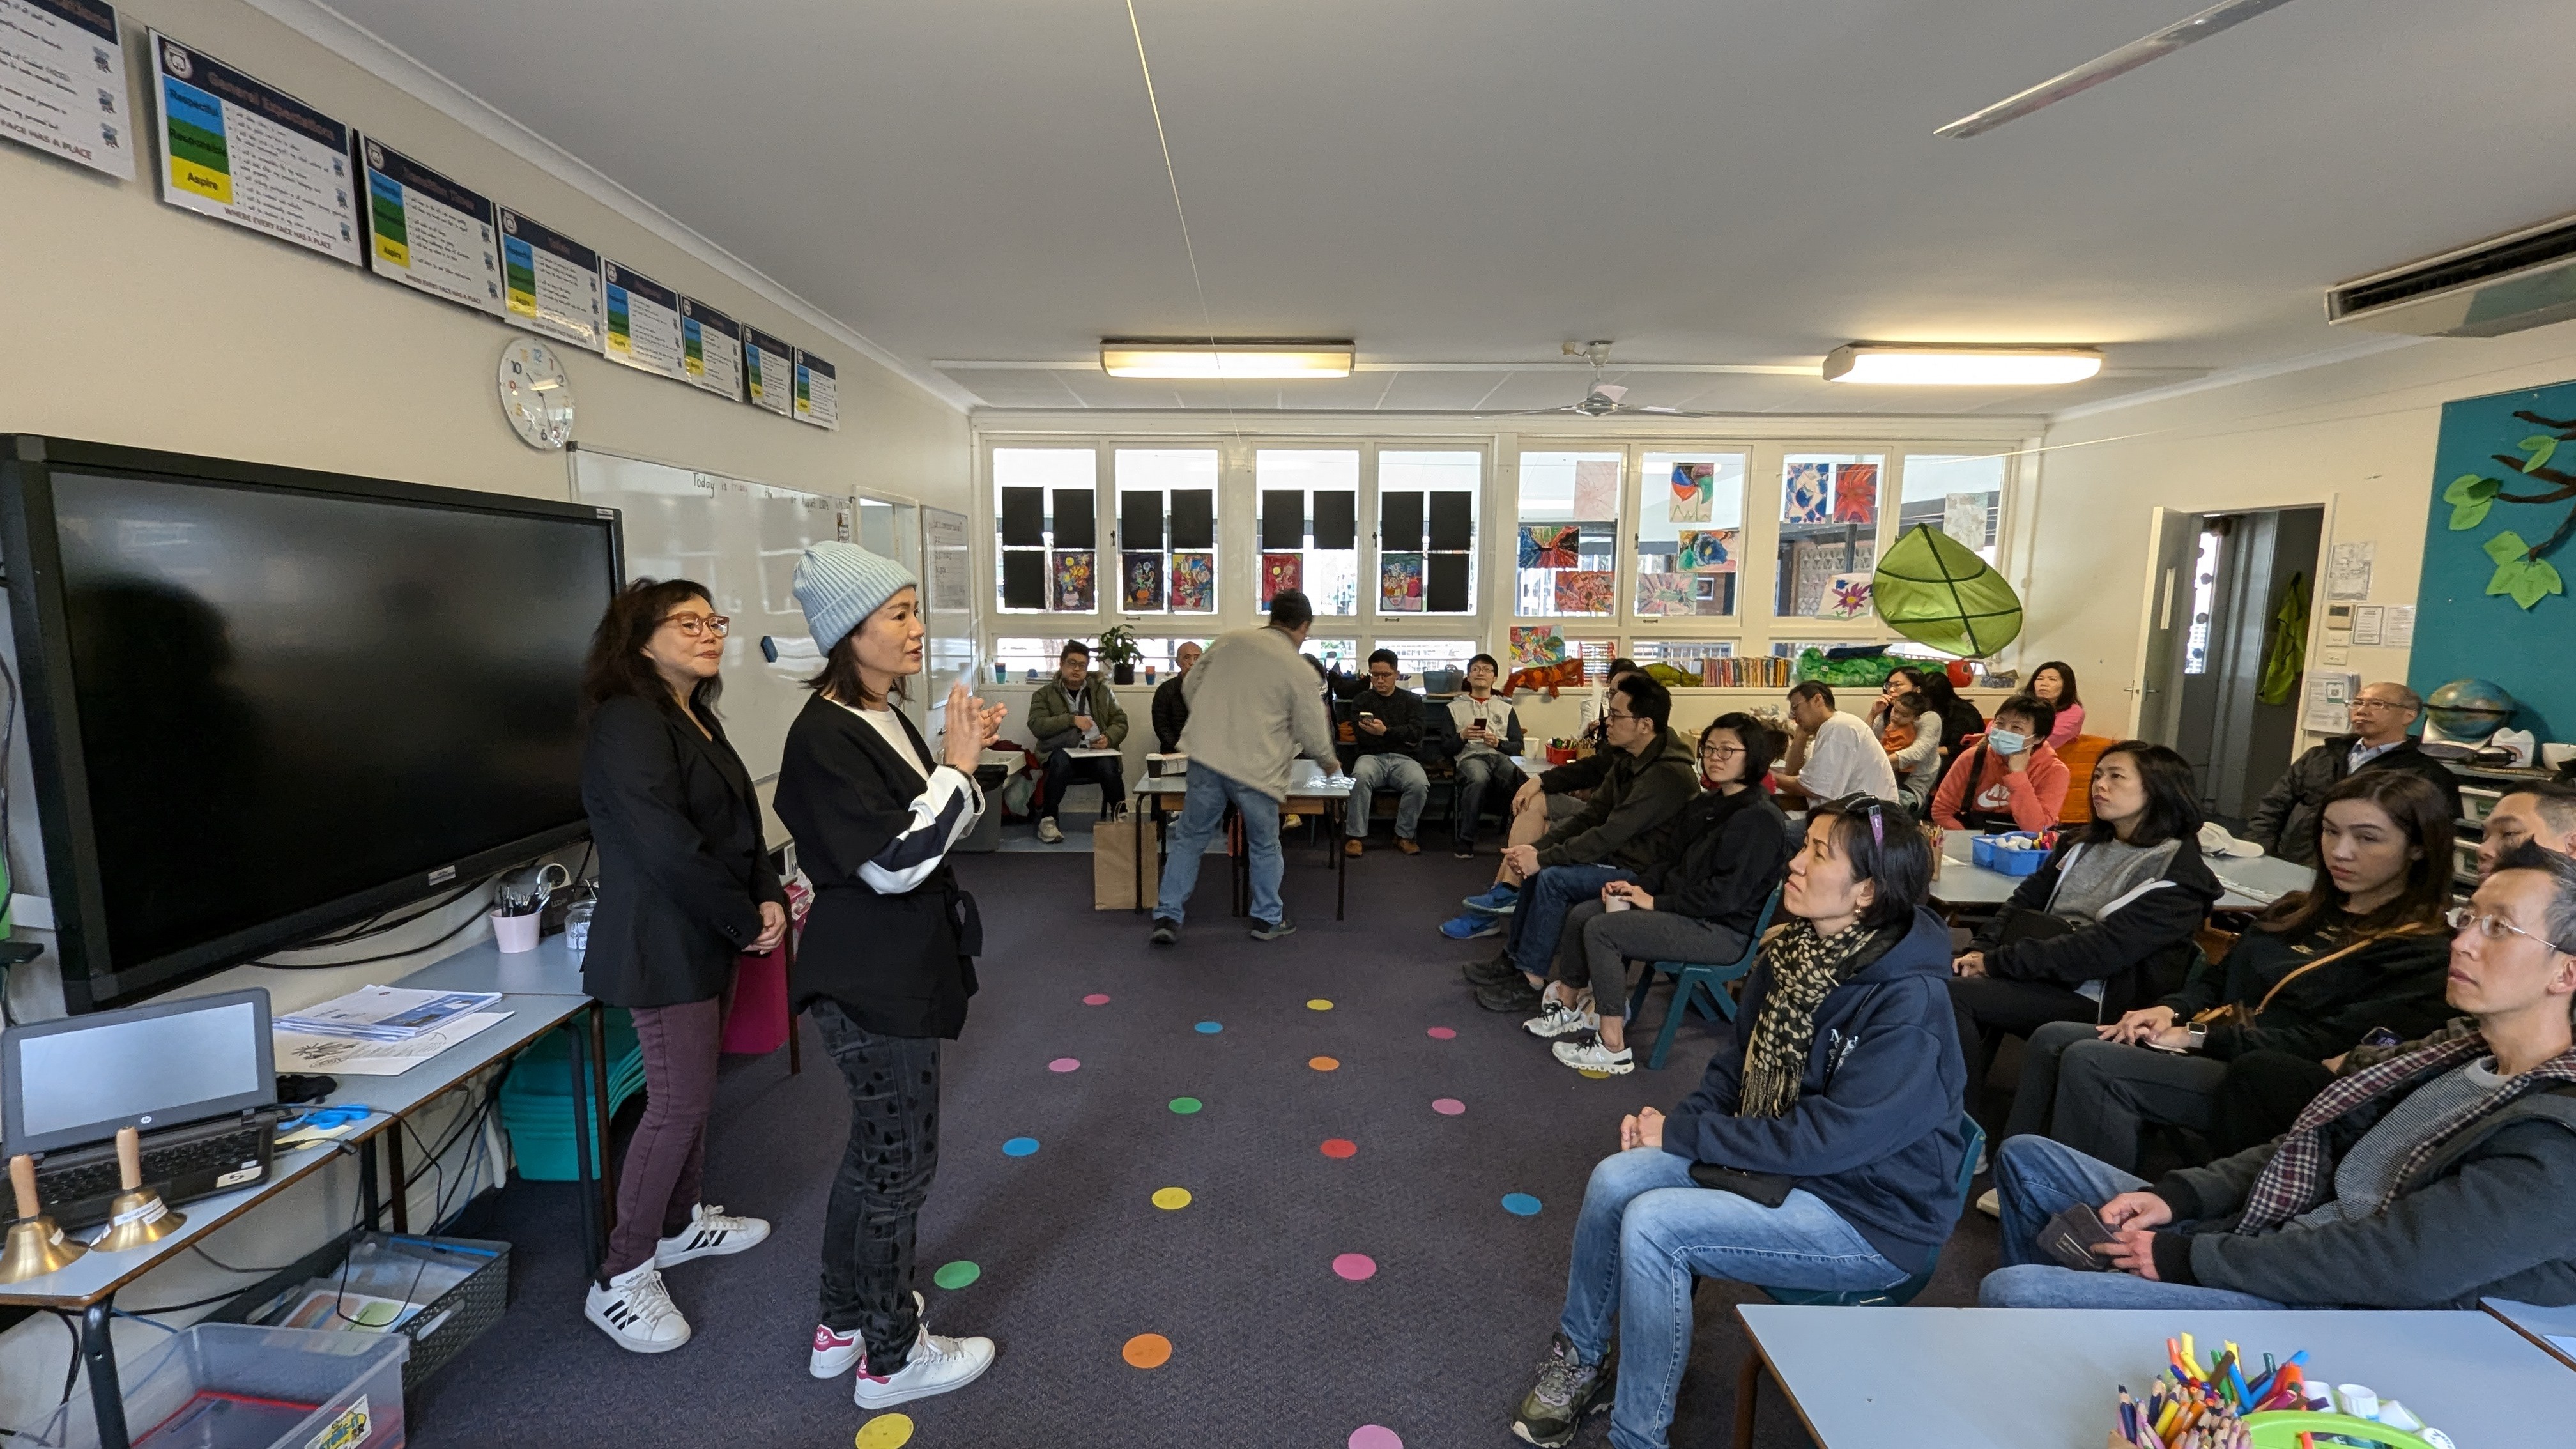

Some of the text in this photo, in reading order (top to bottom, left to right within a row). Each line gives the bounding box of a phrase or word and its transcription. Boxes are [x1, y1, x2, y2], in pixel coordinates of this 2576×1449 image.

[62, 141, 92, 160] PLACE
[187, 171, 218, 191] Aspire
[511, 360, 522, 375] 10
[540, 428, 548, 441] 6
[693, 472, 714, 499] Today
[625, 1272, 644, 1284] adidas
